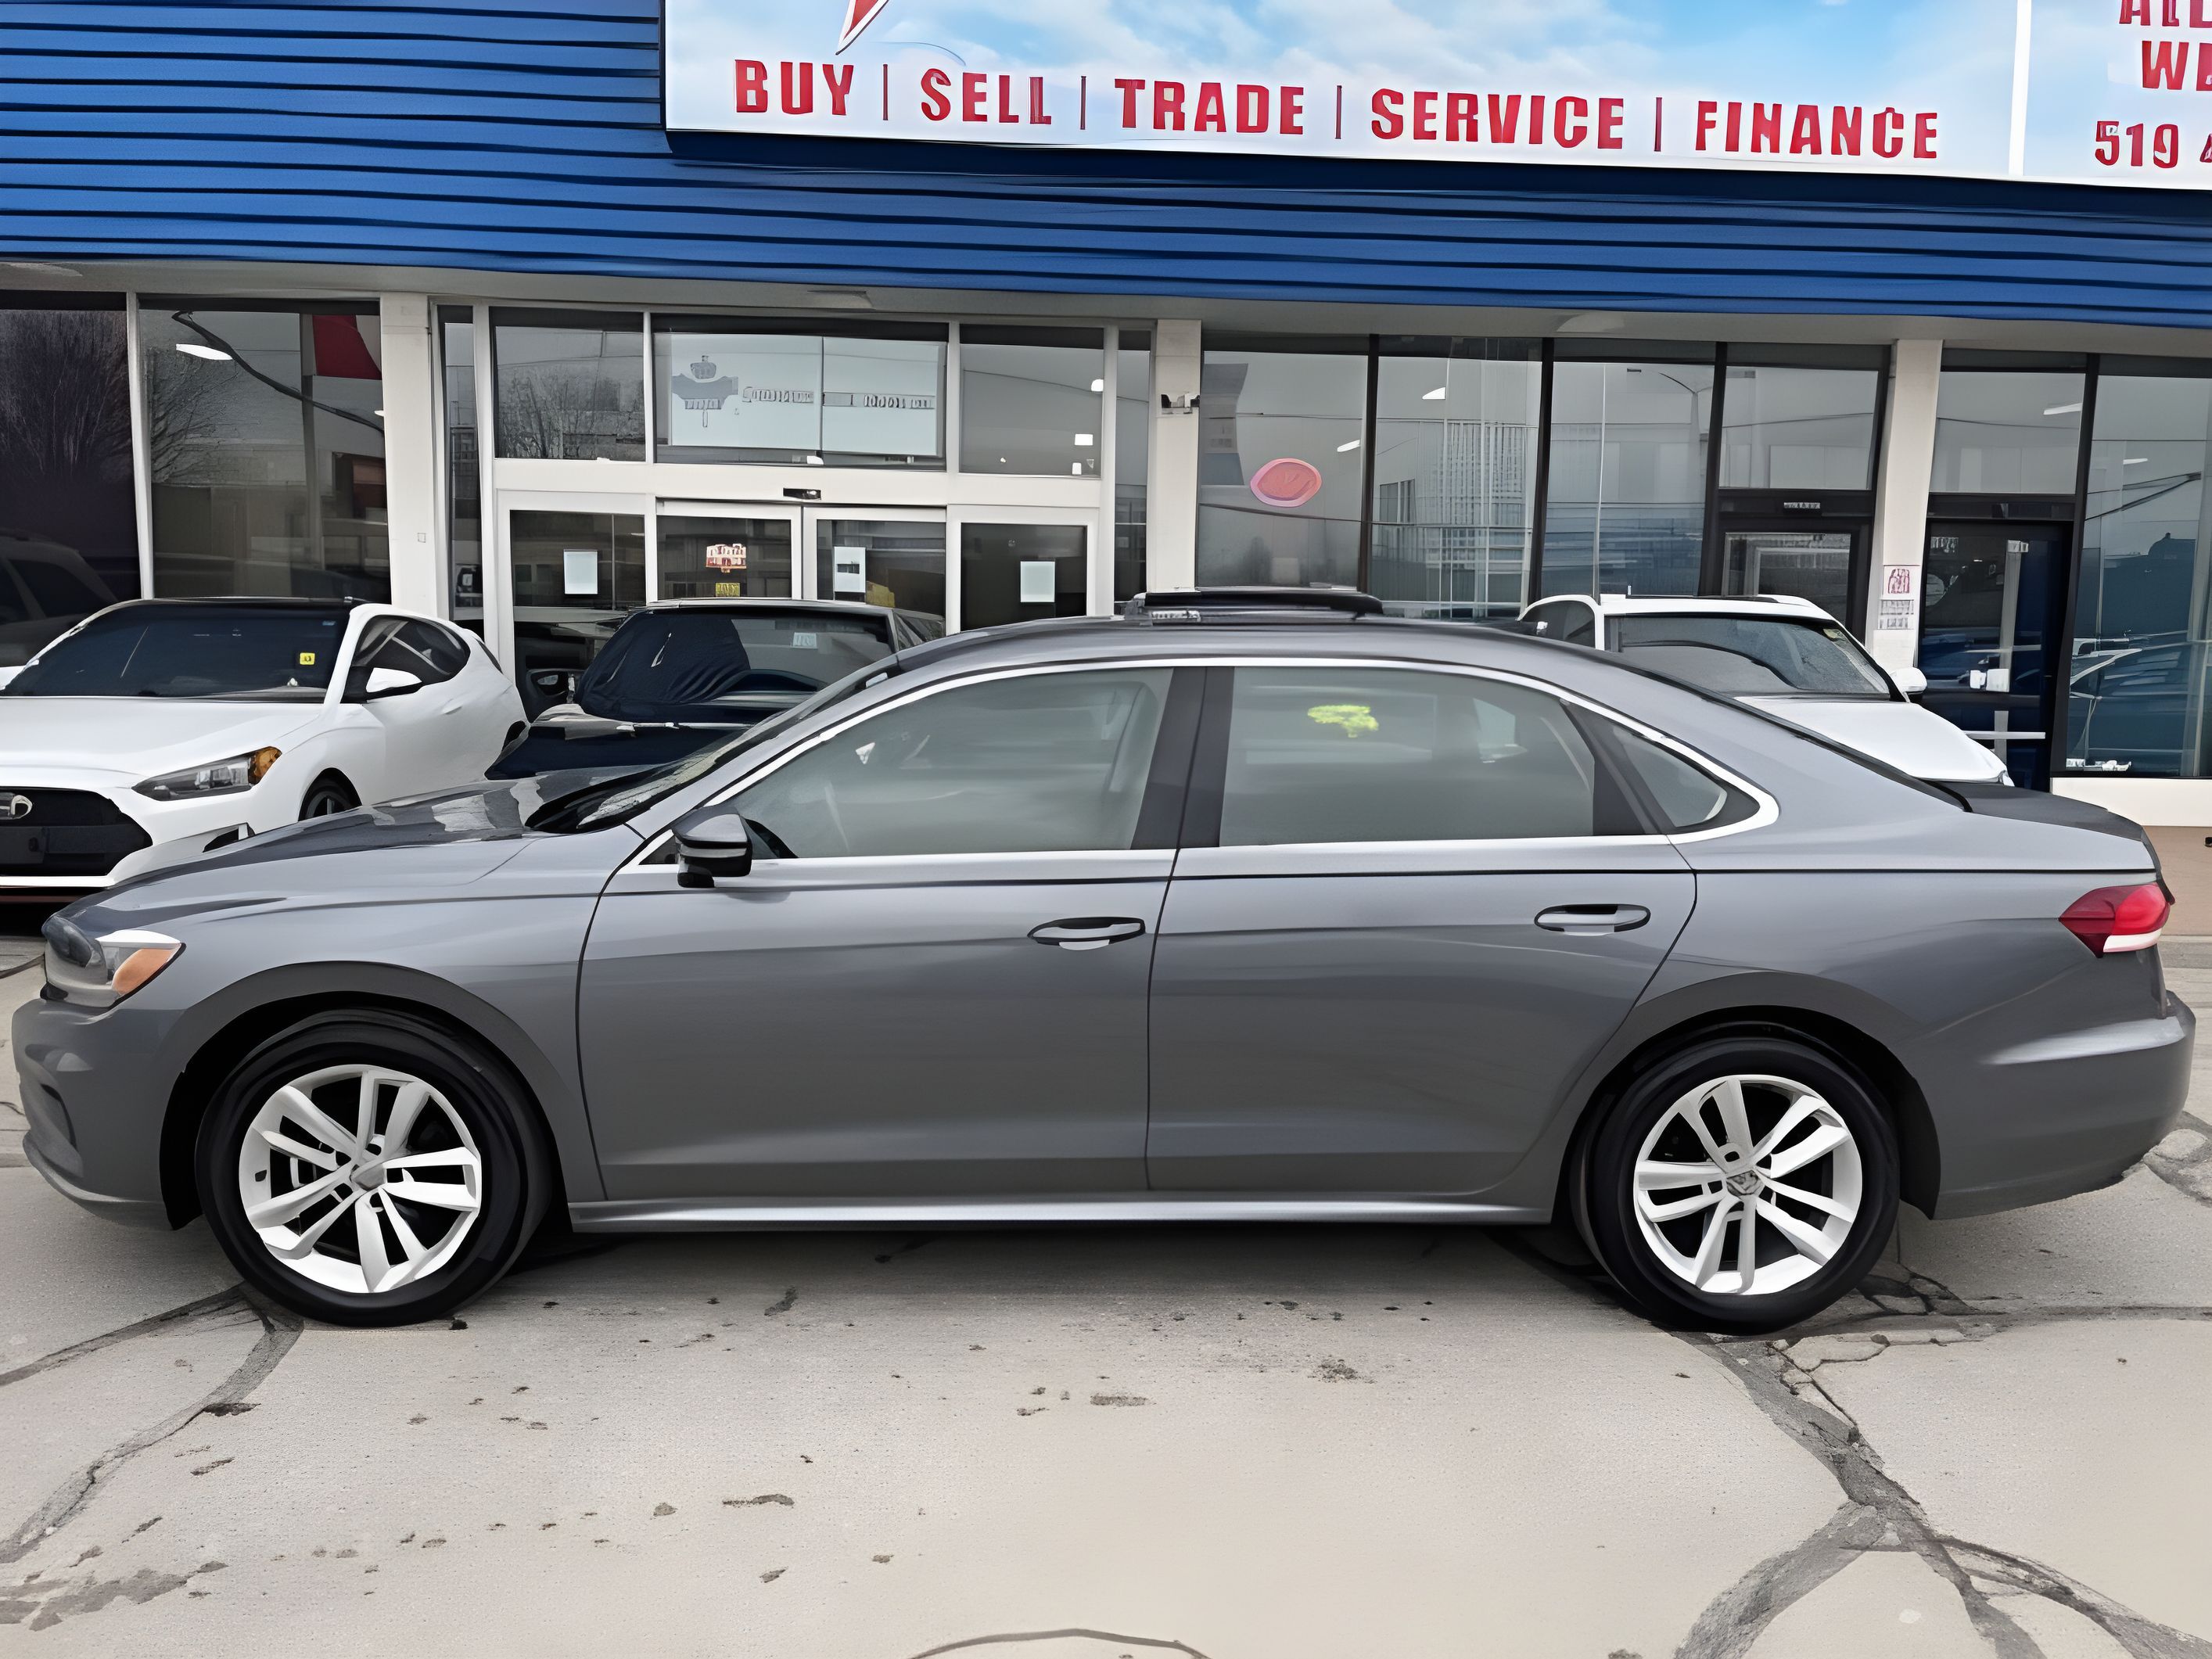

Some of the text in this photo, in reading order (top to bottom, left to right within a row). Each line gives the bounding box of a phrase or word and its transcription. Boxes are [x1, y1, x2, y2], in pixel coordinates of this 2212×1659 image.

[734, 59, 1939, 160] BUY SELL TRADE SERVICE FINANCE
[2095, 120, 2179, 169] 519
